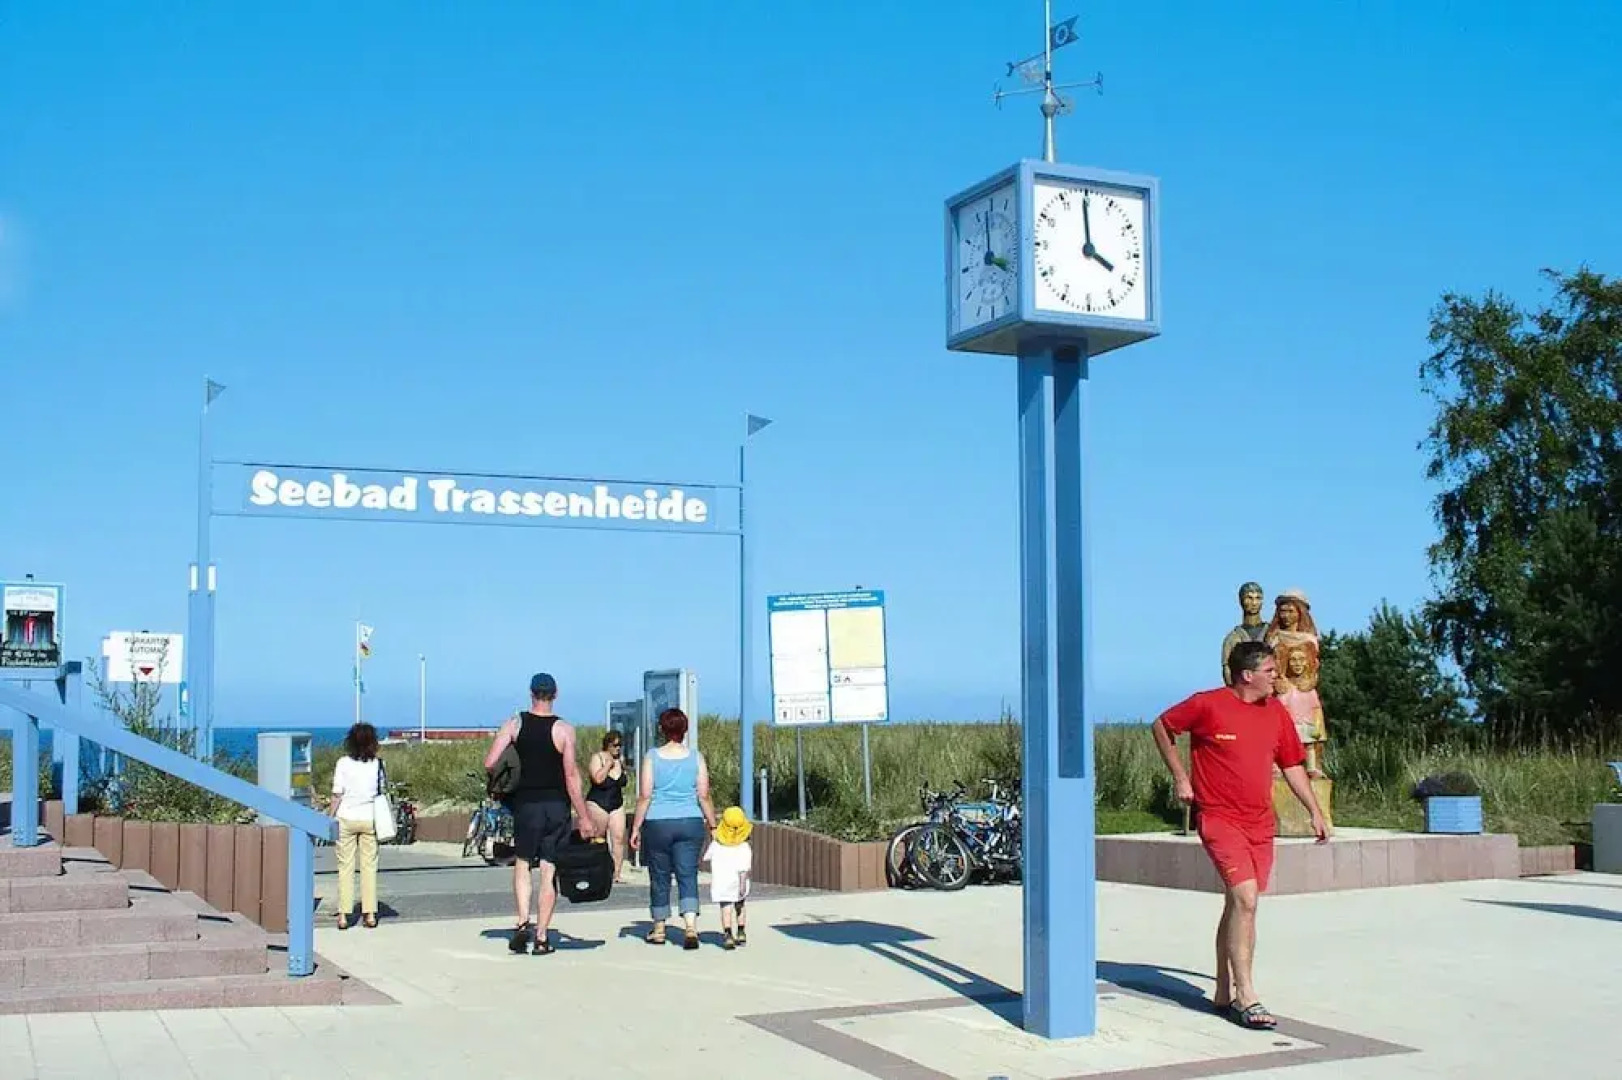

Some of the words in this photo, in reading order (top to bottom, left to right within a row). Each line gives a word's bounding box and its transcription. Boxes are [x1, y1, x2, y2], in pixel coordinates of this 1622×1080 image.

[1062, 201, 1071, 211] 11
[1047, 218, 1056, 228] 10
[250, 471, 418, 511] Seebad
[428, 479, 706, 524] Trassenheide
